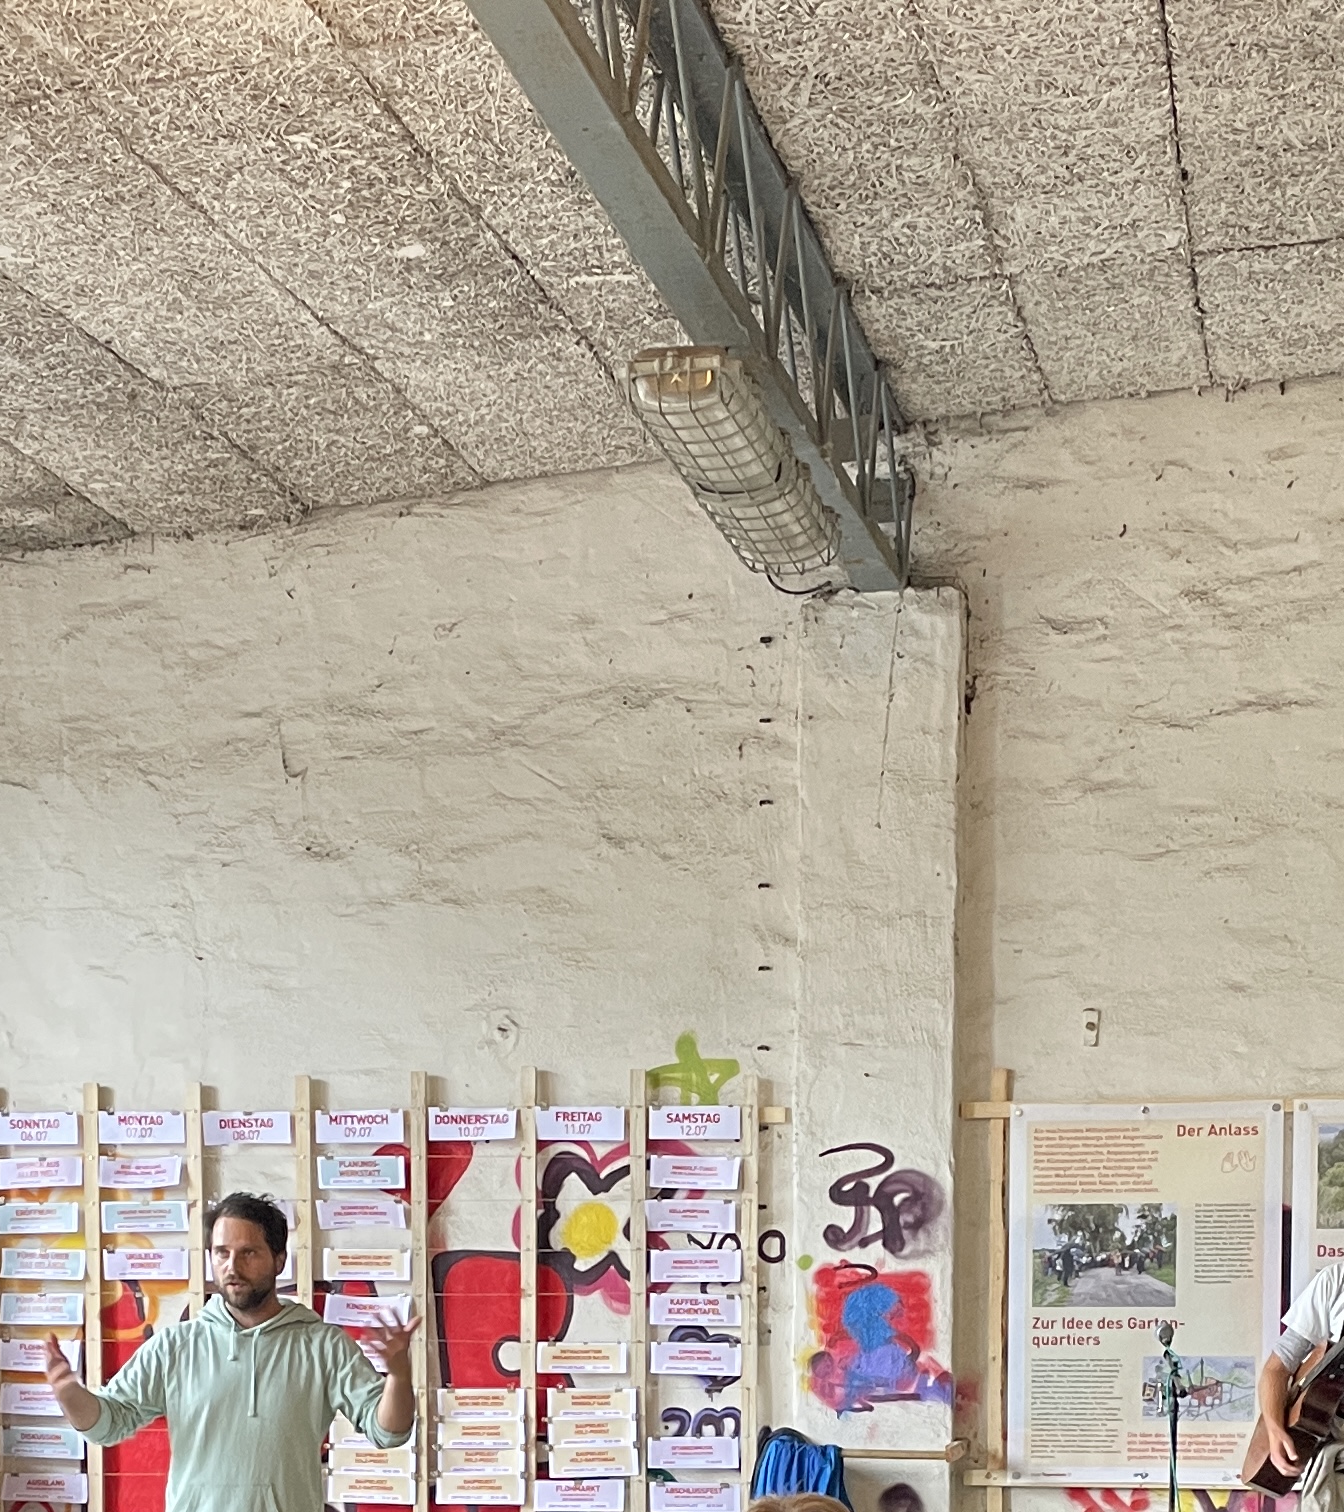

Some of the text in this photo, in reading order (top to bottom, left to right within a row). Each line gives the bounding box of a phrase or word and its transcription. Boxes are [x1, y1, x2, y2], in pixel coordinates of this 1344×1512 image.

[117, 1115, 164, 1126] MONTAG
[329, 1114, 389, 1125] MITTWOCH
[434, 1113, 509, 1125] DONNERSTAG
[555, 1111, 602, 1122] FREITAG
[666, 1112, 721, 1125] SAMSTAG
[9, 1118, 60, 1130] SONNTAG
[219, 1118, 274, 1129] DIENSTAG
[1176, 1123, 1259, 1137] Der Anlass
[1317, 1244, 1344, 1257] Das
[1032, 1317, 1057, 1330] Zur
[1062, 1317, 1093, 1330] Idee
[1097, 1316, 1123, 1329] des
[1032, 1333, 1101, 1348] quartiers
